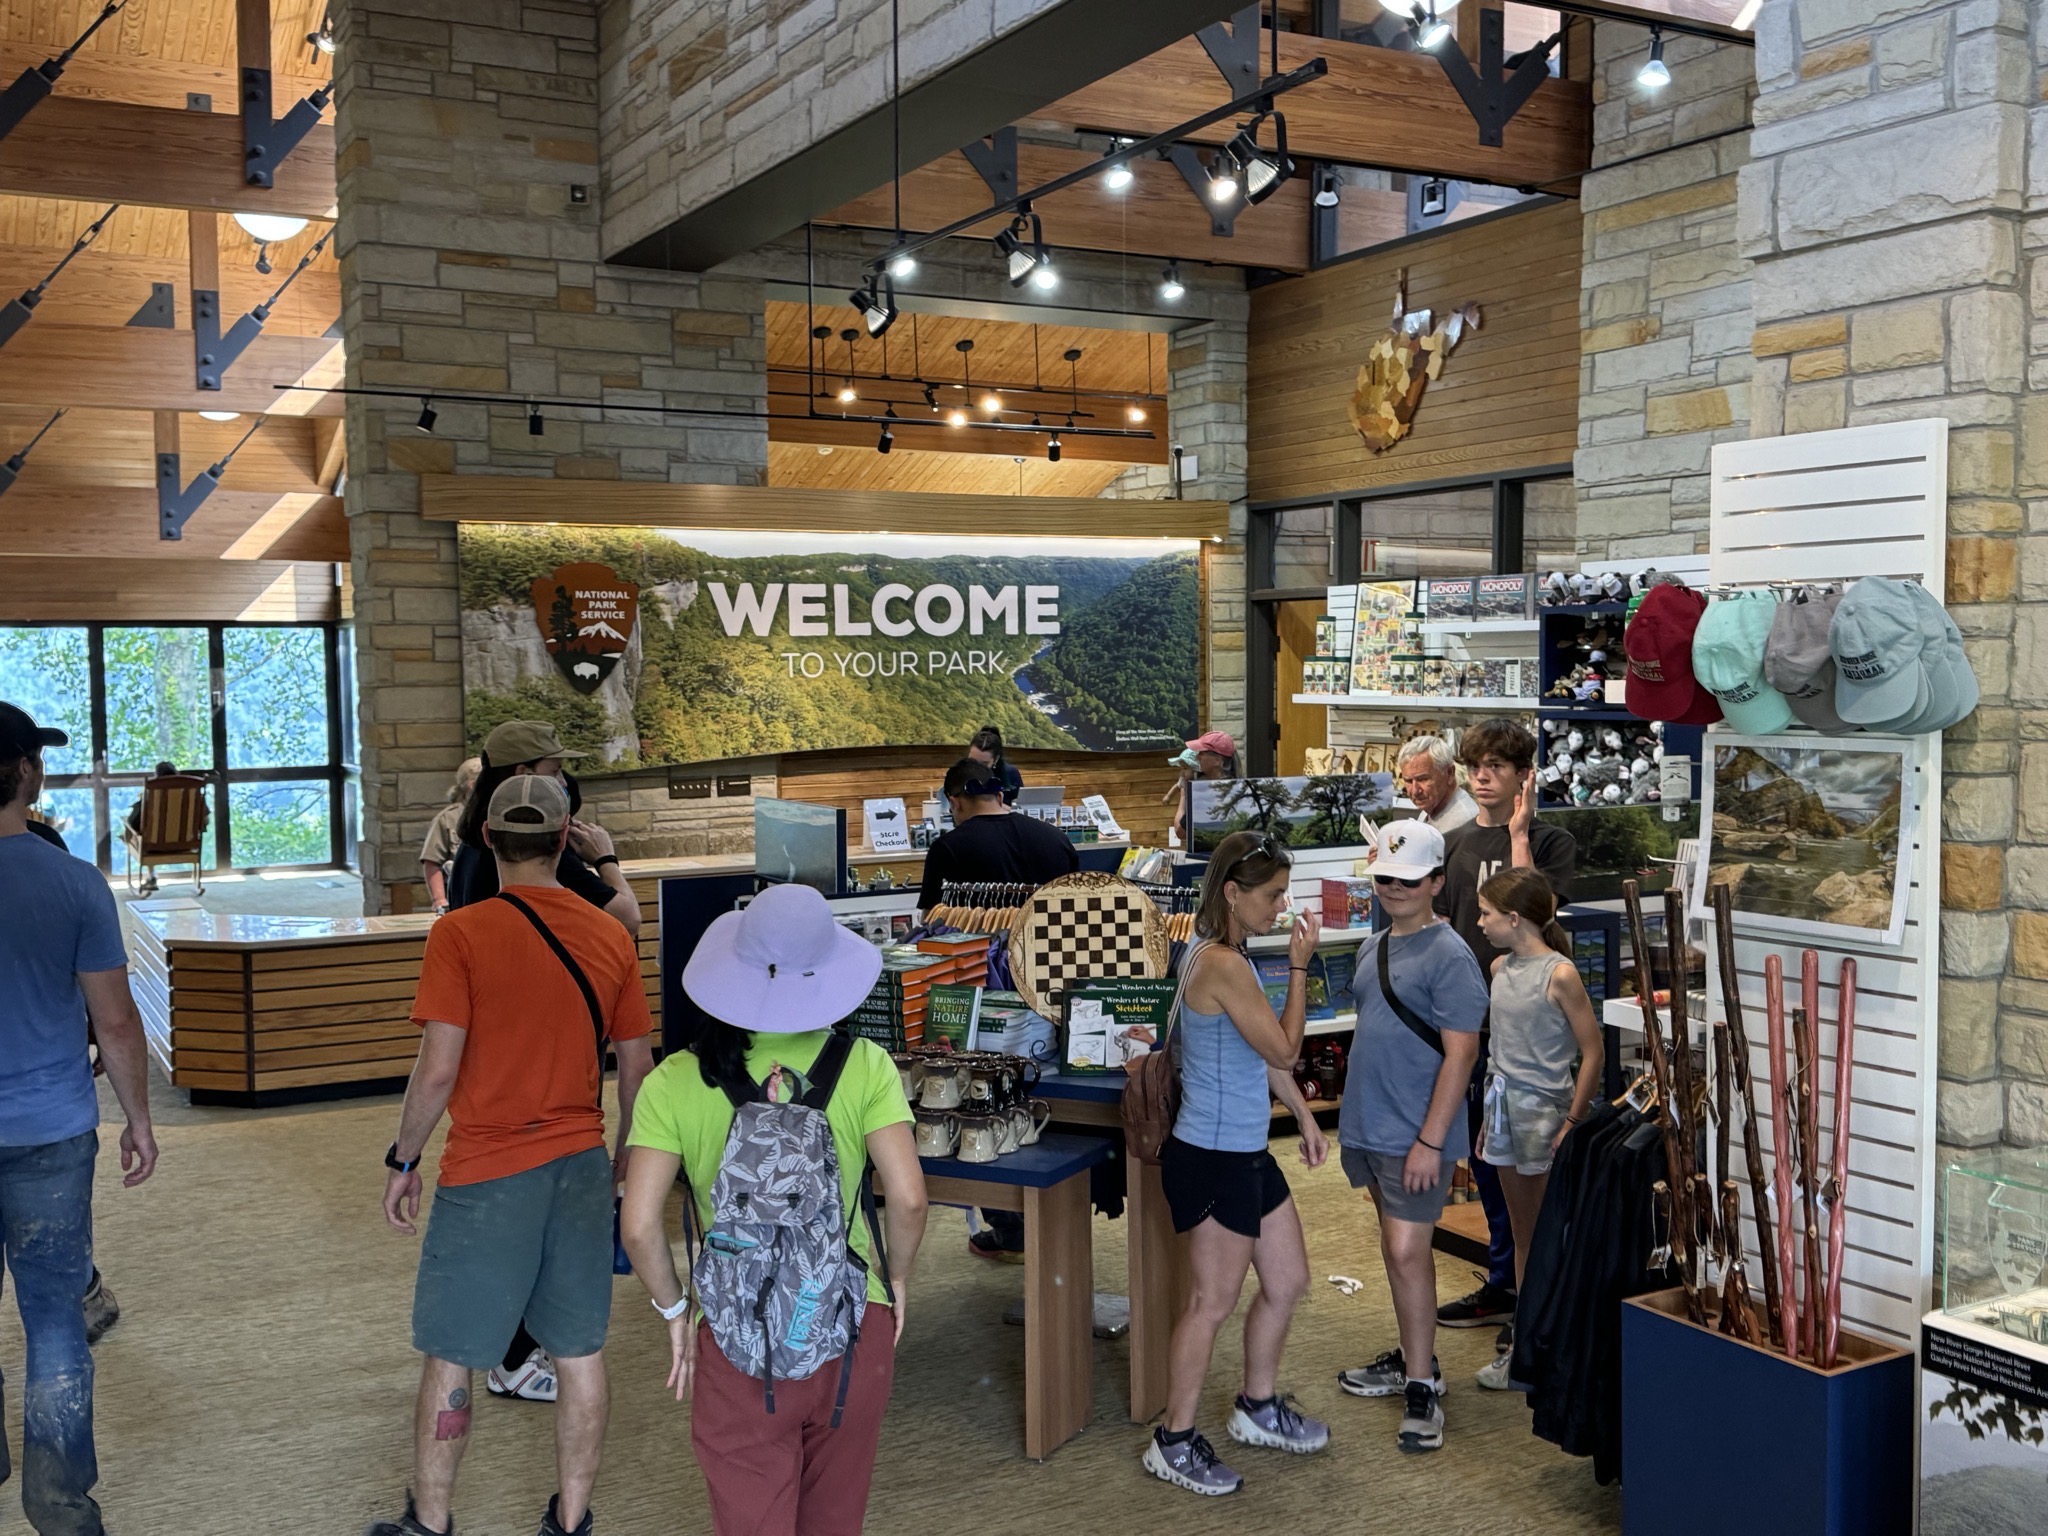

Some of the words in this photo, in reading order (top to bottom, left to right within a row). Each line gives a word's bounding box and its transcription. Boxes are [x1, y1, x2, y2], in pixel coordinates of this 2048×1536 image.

[1432, 584, 1470, 594] MONOPOLY
[1481, 581, 1522, 592] MONOPOLY
[575, 590, 630, 599] NATIONAL
[707, 582, 1060, 636] WELCOME
[581, 611, 625, 619] SERVICE
[780, 652, 824, 678] TO
[834, 651, 920, 678] YOUR
[929, 650, 1004, 675] PARK
[875, 839, 908, 847] Checkout
[935, 996, 970, 1005] BRINGING
[934, 1004, 969, 1013] NATURE
[1116, 1004, 1153, 1012] Sketchbook
[933, 1012, 967, 1024] HOME
[1930, 1332, 1945, 1344] New
[1946, 1337, 1962, 1349] River
[1963, 1342, 1984, 1356] Gorge
[1984, 1348, 2013, 1364] National
[2013, 1358, 2031, 1371] River
[1930, 1341, 1962, 1360] Bluestone
[1963, 1351, 1990, 1368] National
[1992, 1360, 2013, 1376] Scenic
[2014, 1369, 2032, 1382] River
[1930, 1352, 1952, 1368] Gauley
[1954, 1359, 1970, 1373] River
[1970, 1366, 1999, 1382] National
[2000, 1376, 2036, 1394] Recreation
[2037, 1386, 2048, 1400] Are
